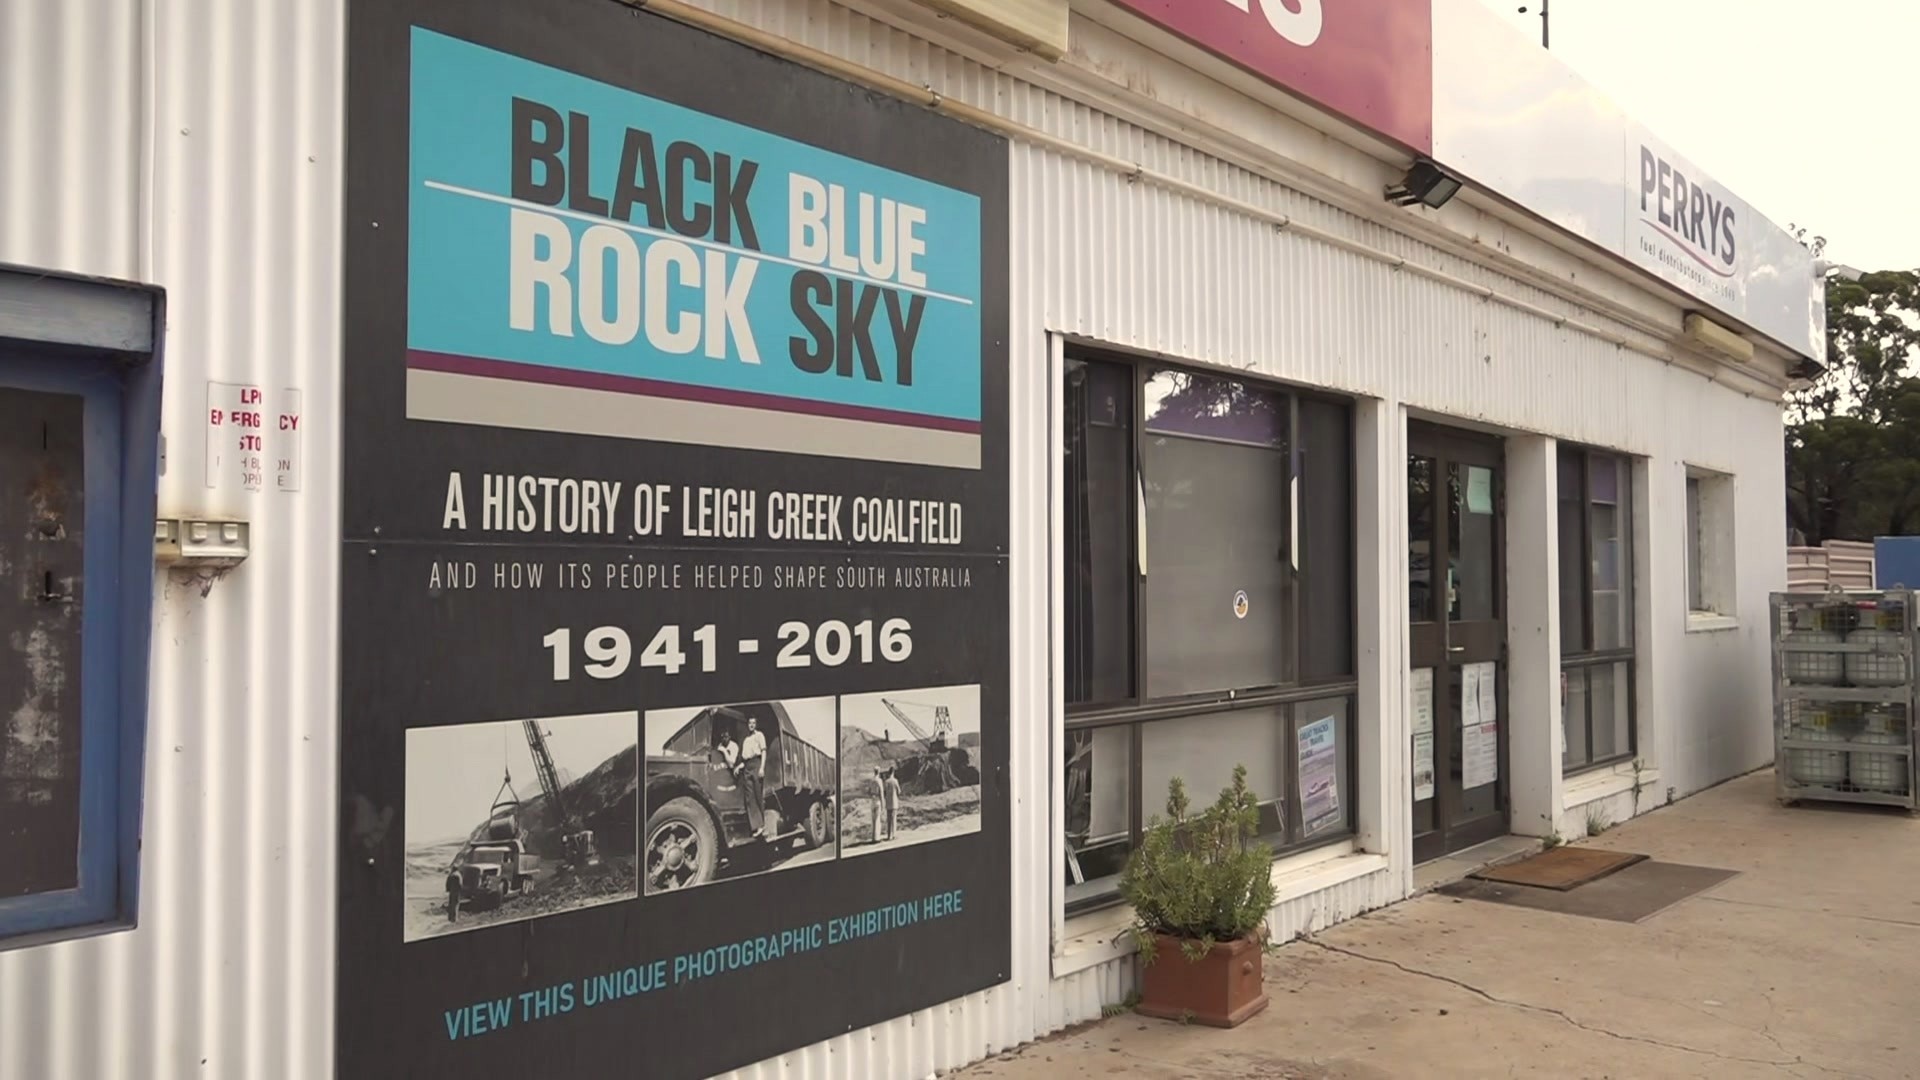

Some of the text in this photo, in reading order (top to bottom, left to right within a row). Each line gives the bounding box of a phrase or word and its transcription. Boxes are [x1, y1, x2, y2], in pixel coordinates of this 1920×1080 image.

[511, 96, 926, 288] BLACK BLUE
[1640, 144, 1735, 266] PERRYS
[509, 207, 927, 386] ROCK SKY
[1640, 236, 1656, 257] fuel
[1659, 249, 1701, 285] distributors
[442, 471, 962, 545] A HISTORY OF LEIGH CREEK COALFIELD
[429, 562, 972, 589] AND HOW ITS PEOPLE HELPED SHAPE SOUTH AUSTRALIA
[543, 618, 913, 680] 1941 - 2016
[444, 889, 963, 1040] VIEW THIS UNIQUE PHOTOGRAPHIC EXHIBITION HERE
